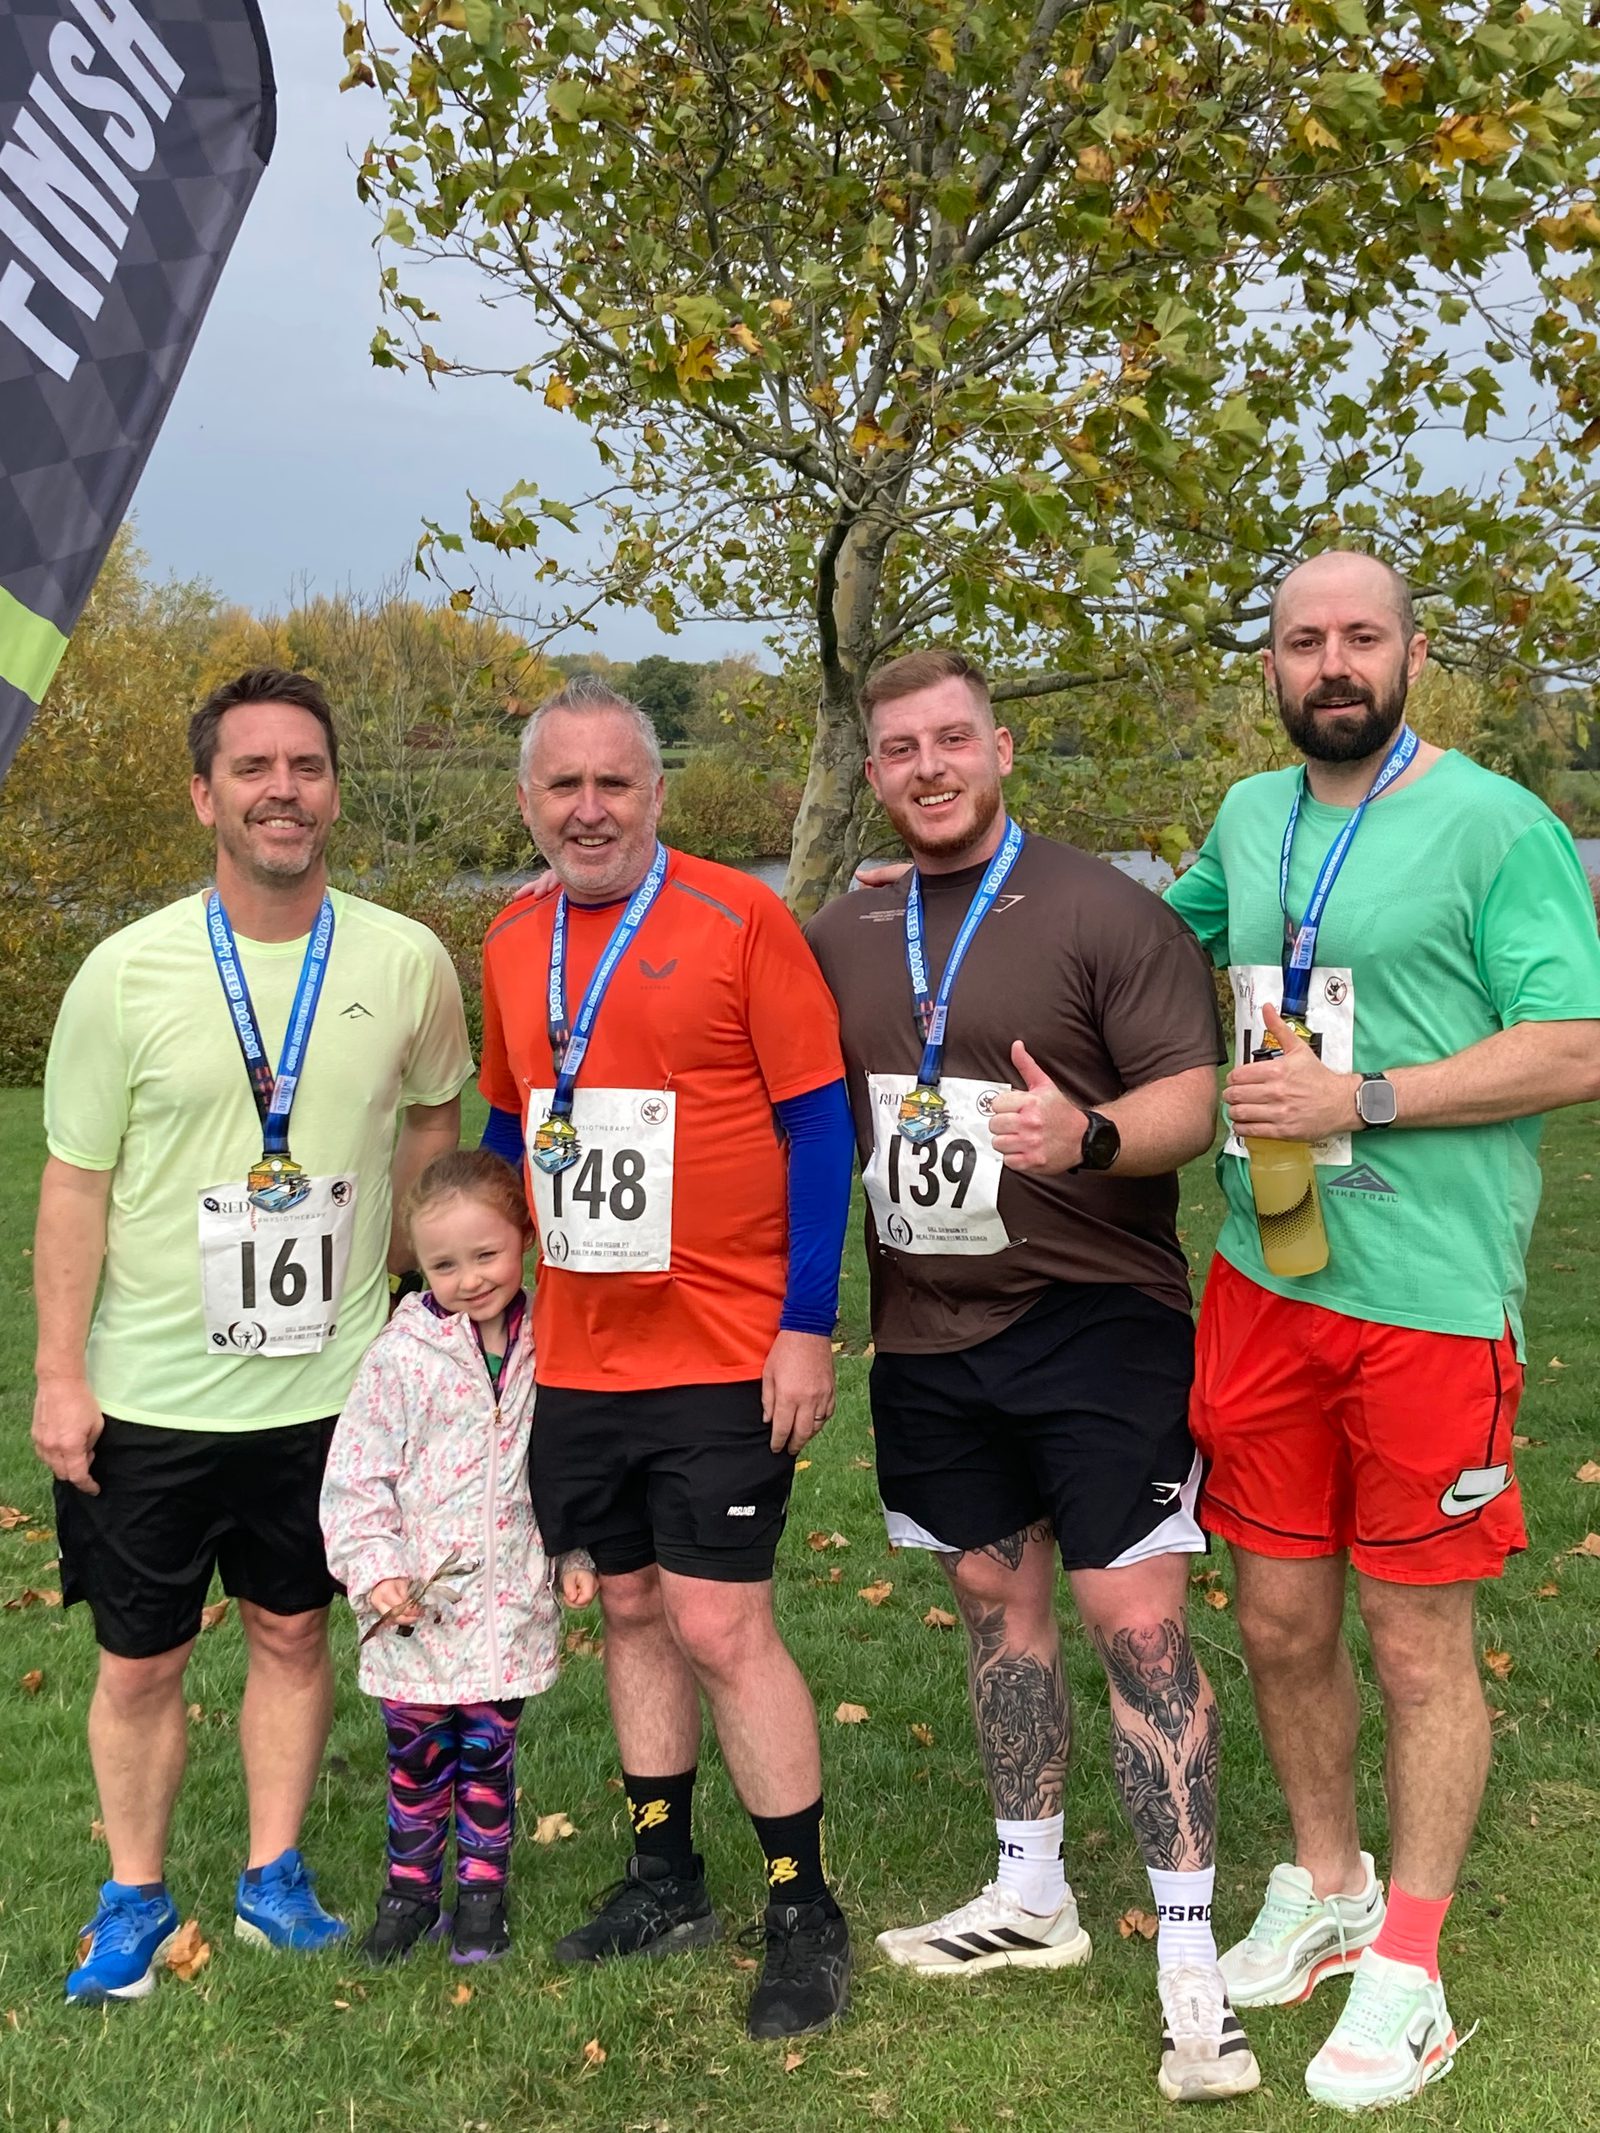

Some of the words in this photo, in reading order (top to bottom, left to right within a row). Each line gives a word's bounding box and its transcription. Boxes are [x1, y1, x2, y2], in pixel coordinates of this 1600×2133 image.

[983, 842, 1018, 895] ROADS?
[625, 872, 661, 927] ROADS?
[906, 905, 920, 940] NEED
[210, 914, 233, 958] DON'T
[220, 960, 244, 1000] NEED
[549, 965, 565, 1022] ROADS!
[908, 940, 929, 995] ROADS!
[232, 1000, 262, 1060] ROADS!
[553, 1148, 648, 1222] 148
[888, 1134, 978, 1210] 139
[1327, 1188, 1357, 1199] NIKE
[1359, 1192, 1399, 1203] TRAIL
[257, 1212, 327, 1224] PHYSIOTHERAPY
[241, 1234, 334, 1309] 161
